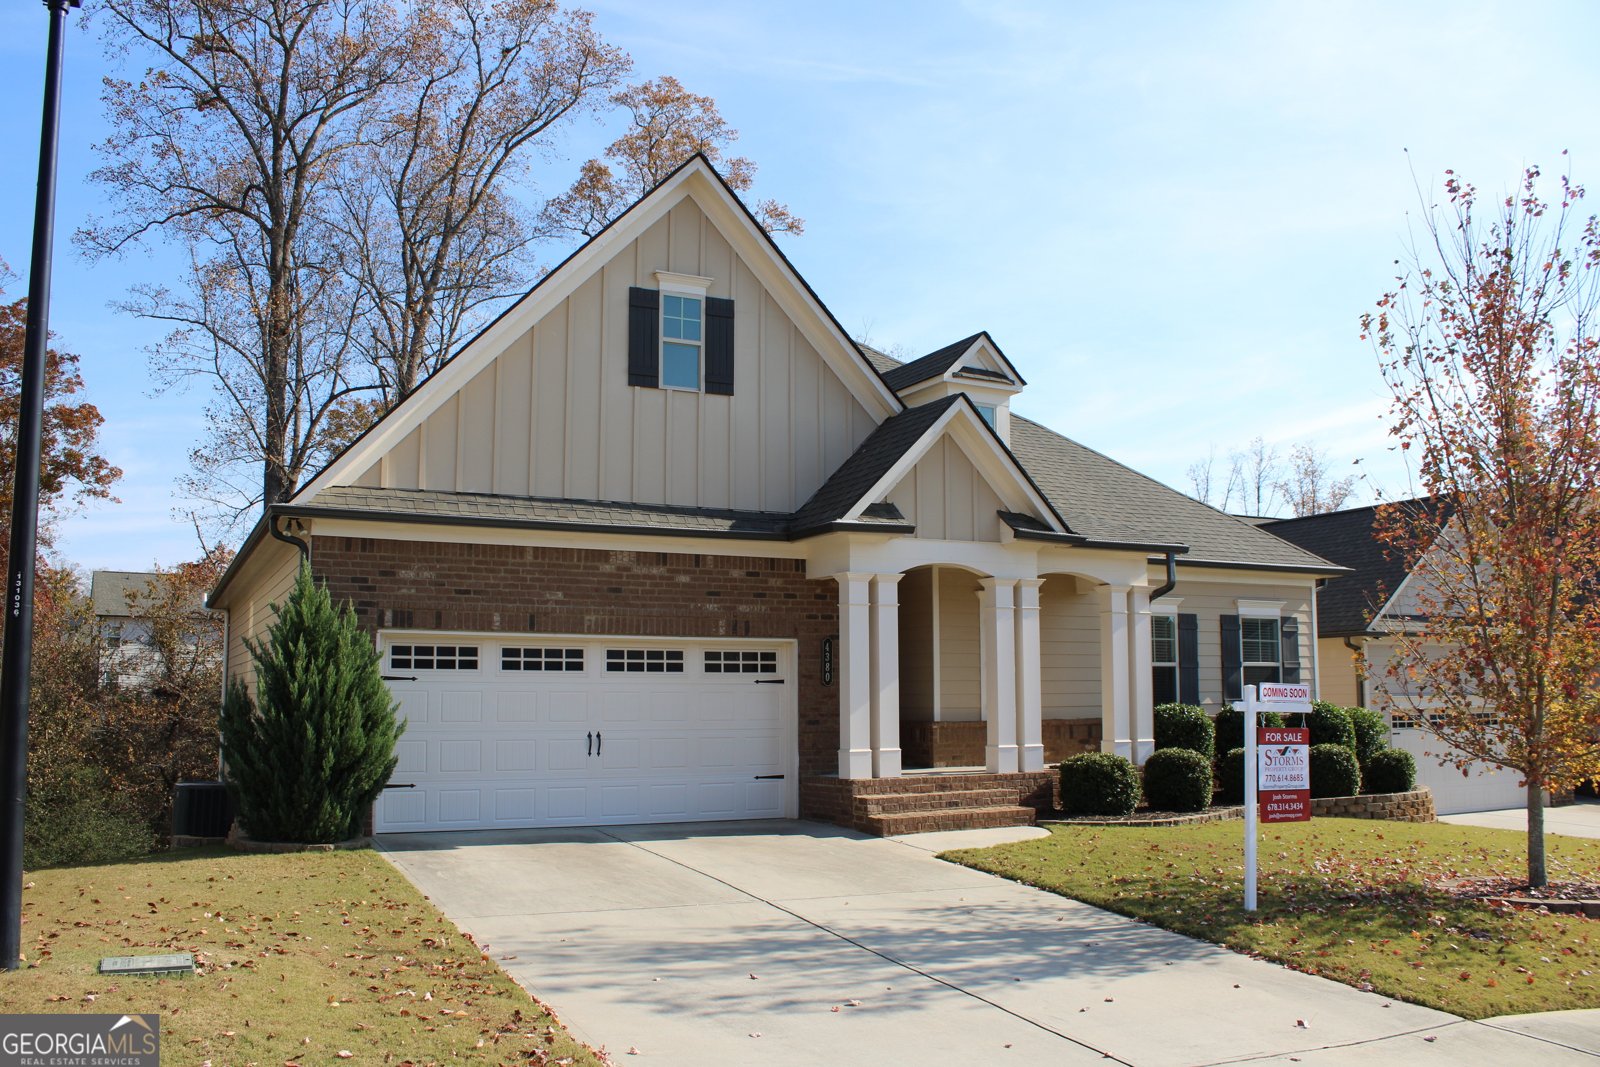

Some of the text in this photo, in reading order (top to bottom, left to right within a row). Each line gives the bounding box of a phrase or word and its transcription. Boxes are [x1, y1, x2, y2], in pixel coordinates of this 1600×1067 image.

[1263, 687, 1307, 698] COMING SOON
[1265, 732, 1302, 742] FOR SALE
[1264, 749, 1304, 766] STORMS
[1265, 774, 1304, 783] 770.614.8685
[1267, 802, 1304, 811] 678.314.3434
